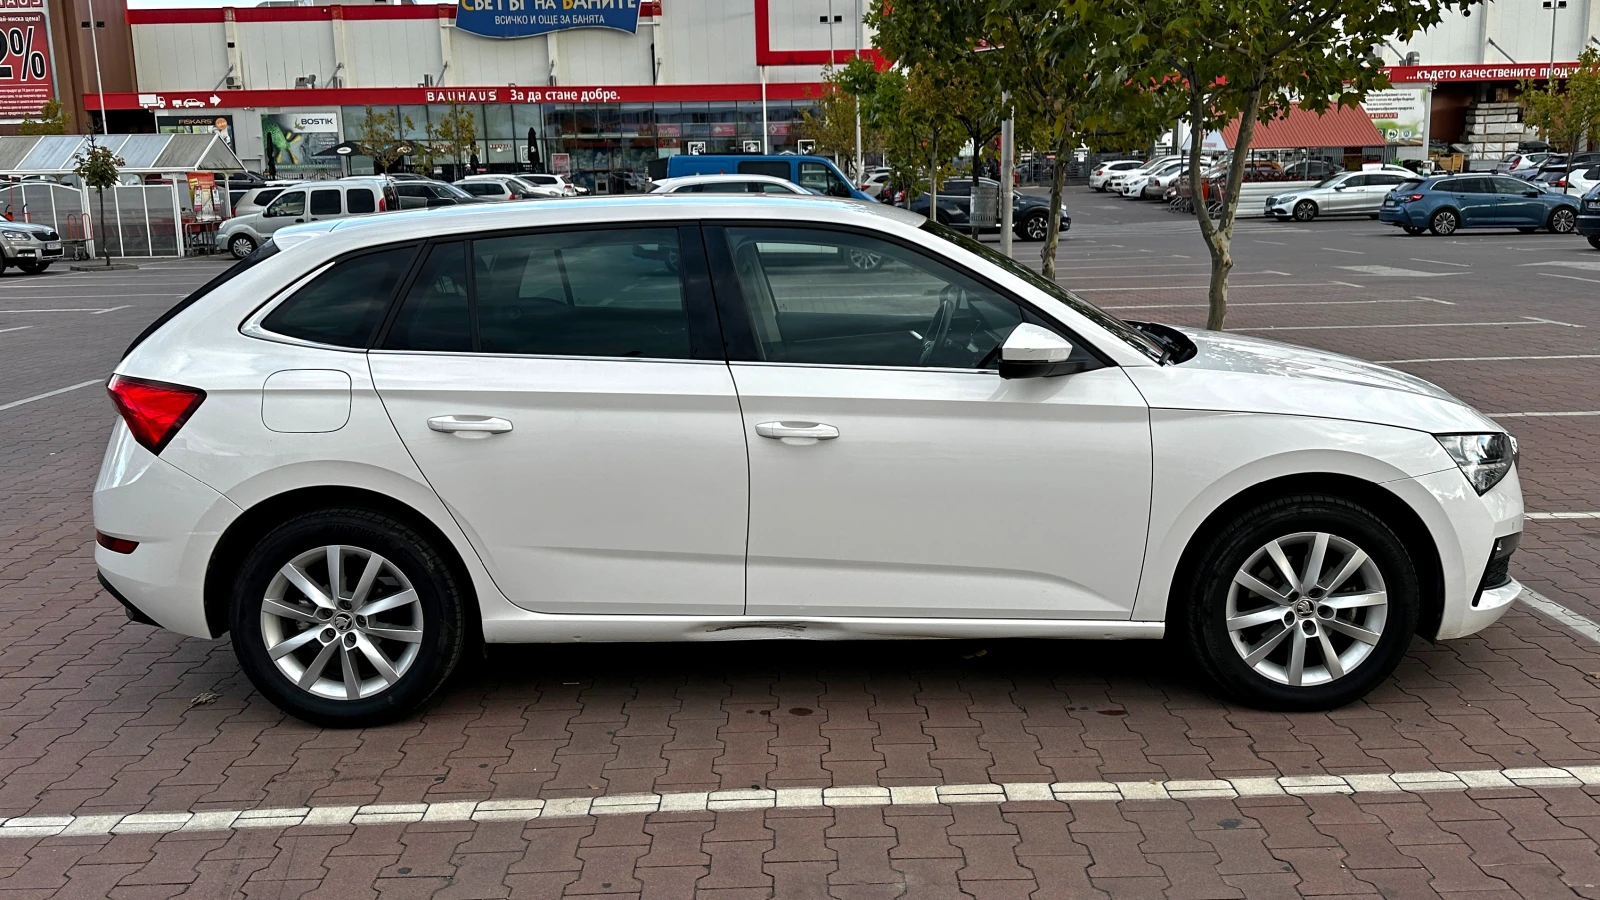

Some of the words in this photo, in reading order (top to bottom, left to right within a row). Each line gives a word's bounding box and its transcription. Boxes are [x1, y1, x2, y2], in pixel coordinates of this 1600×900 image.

[495, 15, 528, 25] ВСИЧКО
[530, 15, 537, 24] И
[538, 15, 558, 26] ОЩЕ
[560, 15, 571, 24] ЗА
[572, 15, 605, 24] БАНЯТА
[1406, 69, 1457, 81] ...където
[1460, 68, 1536, 78] качествените
[427, 91, 497, 102] BAUHAUS
[510, 89, 524, 100] За
[527, 91, 541, 102] да
[545, 91, 578, 100] стане
[581, 88, 621, 102] добре.
